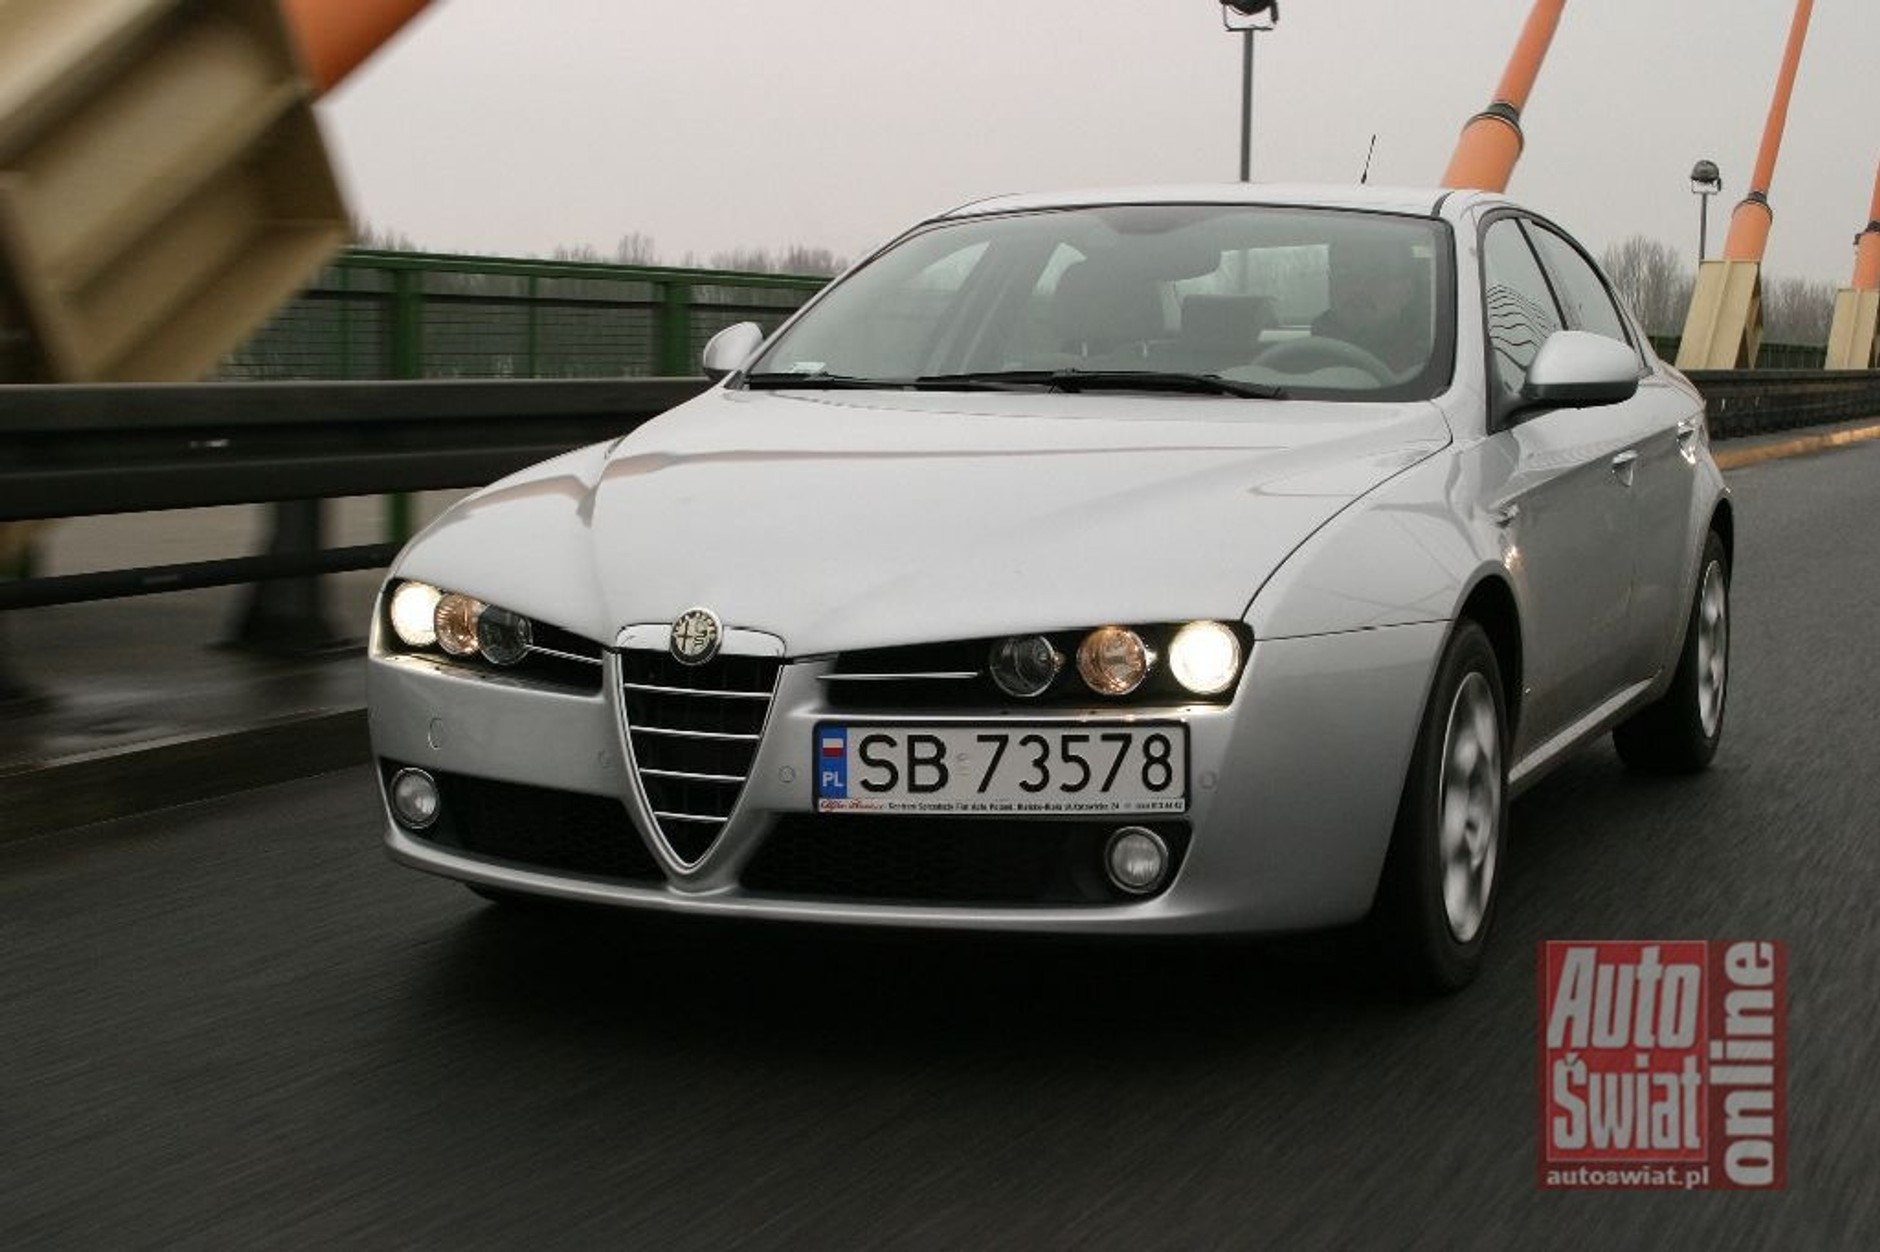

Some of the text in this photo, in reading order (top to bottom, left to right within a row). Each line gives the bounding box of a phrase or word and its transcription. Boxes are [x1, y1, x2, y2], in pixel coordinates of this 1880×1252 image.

[822, 771, 844, 787] PL
[858, 732, 1173, 793] SB 73578
